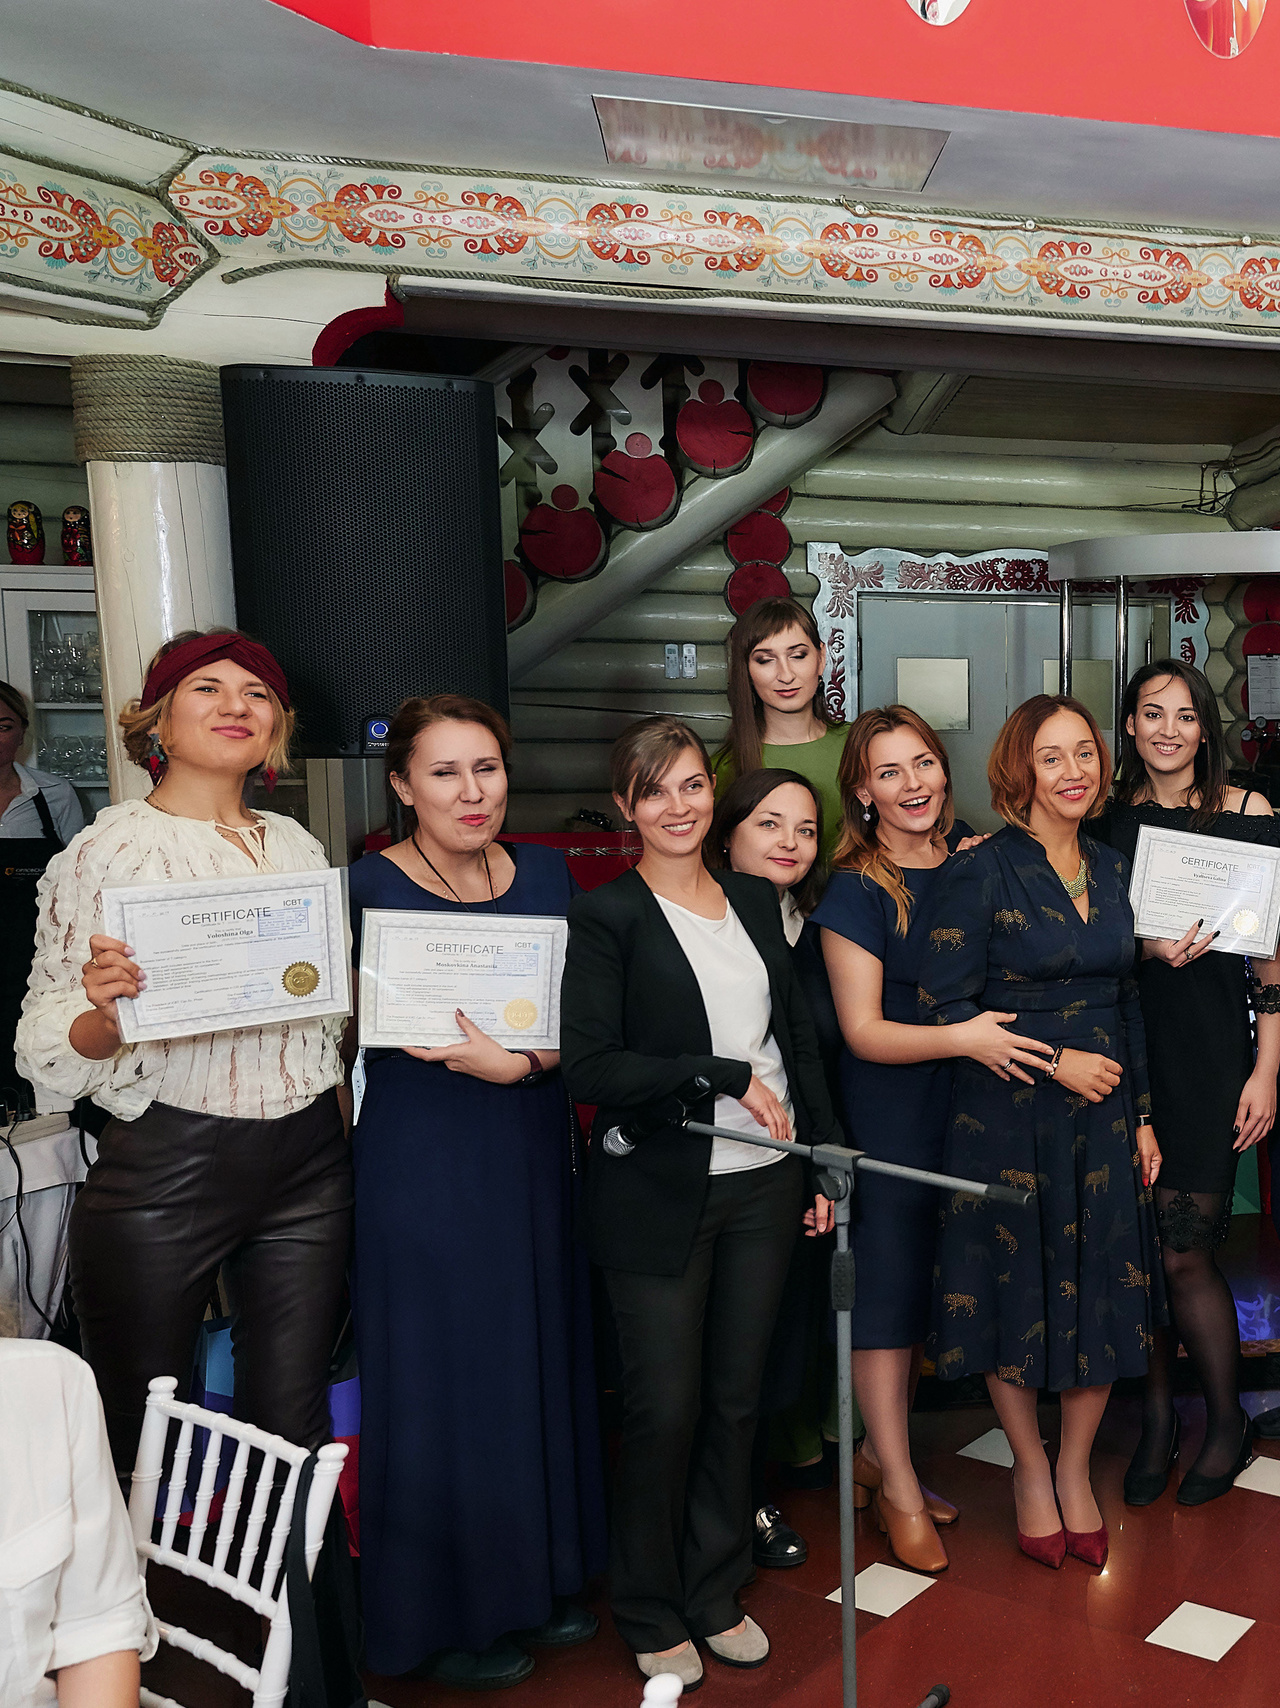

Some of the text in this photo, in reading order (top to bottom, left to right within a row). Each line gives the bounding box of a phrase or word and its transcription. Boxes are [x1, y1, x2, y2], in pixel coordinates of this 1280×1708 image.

[1181, 856, 1239, 872] CERTIFICATE
[283, 899, 302, 907] ICBT
[181, 907, 272, 926] CERTIFICATE
[206, 931, 239, 939] Voloshina
[426, 942, 504, 955] CERTIFICATE
